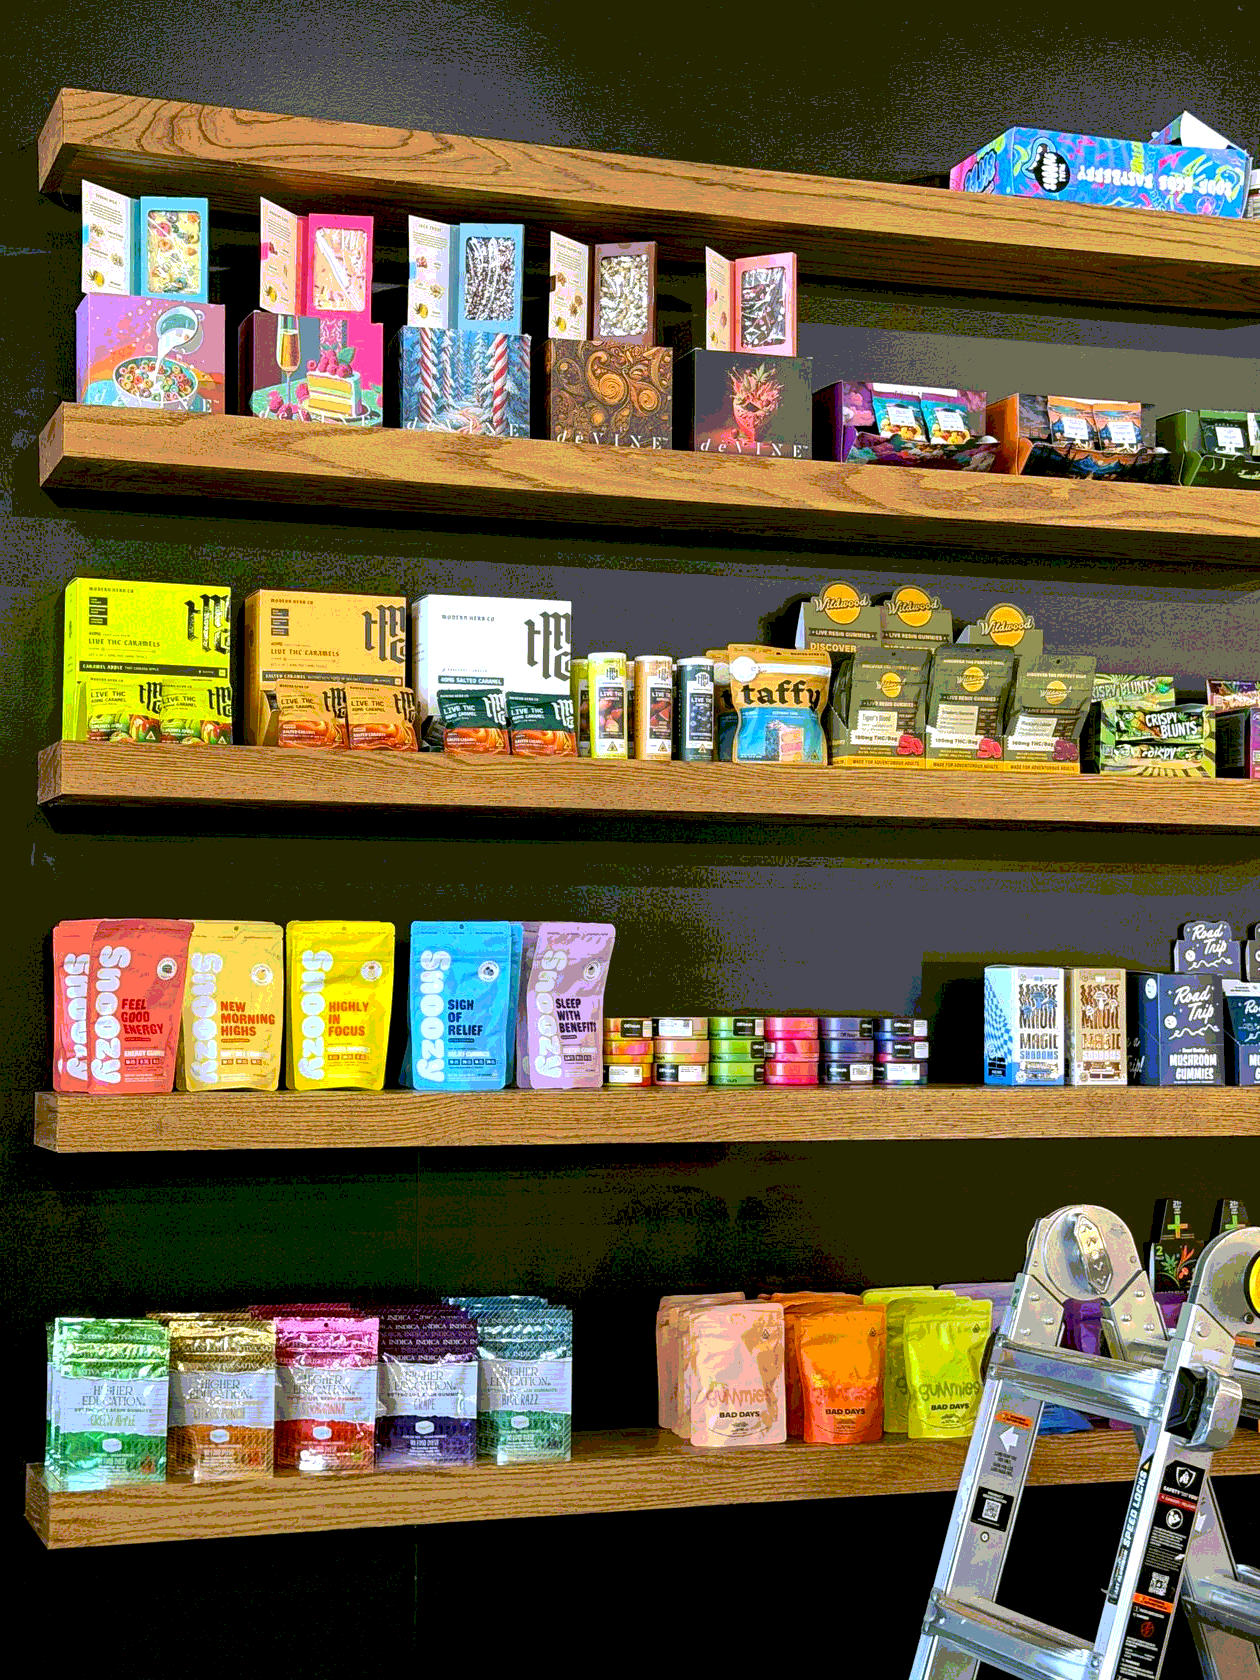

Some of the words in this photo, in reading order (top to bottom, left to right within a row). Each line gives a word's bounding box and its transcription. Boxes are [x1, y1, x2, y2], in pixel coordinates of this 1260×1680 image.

[813, 595, 869, 612] Wildwood
[887, 599, 939, 615] Wildwood
[980, 618, 1034, 635] Wildwood
[124, 640, 160, 648] CARAMELS
[810, 642, 857, 652] DISCOVER
[1092, 683, 1116, 699] RISPY
[1119, 679, 1156, 694] BLUNTS
[741, 680, 820, 712] taffy
[443, 706, 460, 715] LIVE
[511, 707, 528, 715] LIVE
[1145, 712, 1178, 727] CRISPY
[1160, 721, 1198, 738] BLUNTS
[1192, 924, 1224, 941] Road
[1203, 938, 1227, 958] Trip
[1174, 985, 1211, 1005] Road
[121, 998, 146, 1010] FEEL
[220, 1001, 246, 1012] NEW
[328, 1001, 369, 1012] HIGHLY
[447, 999, 474, 1011] SIGH
[555, 998, 581, 1009] SLEEP
[1244, 1000, 1260, 1014] Ro
[121, 1011, 150, 1023] GOOD
[220, 1013, 275, 1025] MORNING
[328, 1014, 340, 1024] IN
[447, 1012, 462, 1023] OF
[557, 1010, 581, 1021] WITH
[1188, 1002, 1214, 1024] Trip
[123, 1023, 164, 1035] ENERGY
[220, 1026, 257, 1036] HIGHS
[328, 1026, 365, 1036] FOCUS
[447, 1025, 483, 1036] RELIEF
[1020, 1033, 1059, 1049] MAGIC
[1169, 1053, 1217, 1066] MUSHROOM
[1175, 1067, 1214, 1080] GUMMIES
[1155, 1245, 1163, 1255] 2
[825, 1408, 844, 1416] BAD
[931, 1403, 948, 1411] BAD
[949, 1402, 970, 1410] DAYS
[719, 1411, 738, 1419] BAD
[739, 1410, 760, 1418] DAYS
[1123, 1507, 1139, 1548] SPEED
[1135, 1470, 1148, 1505] LOCKS
